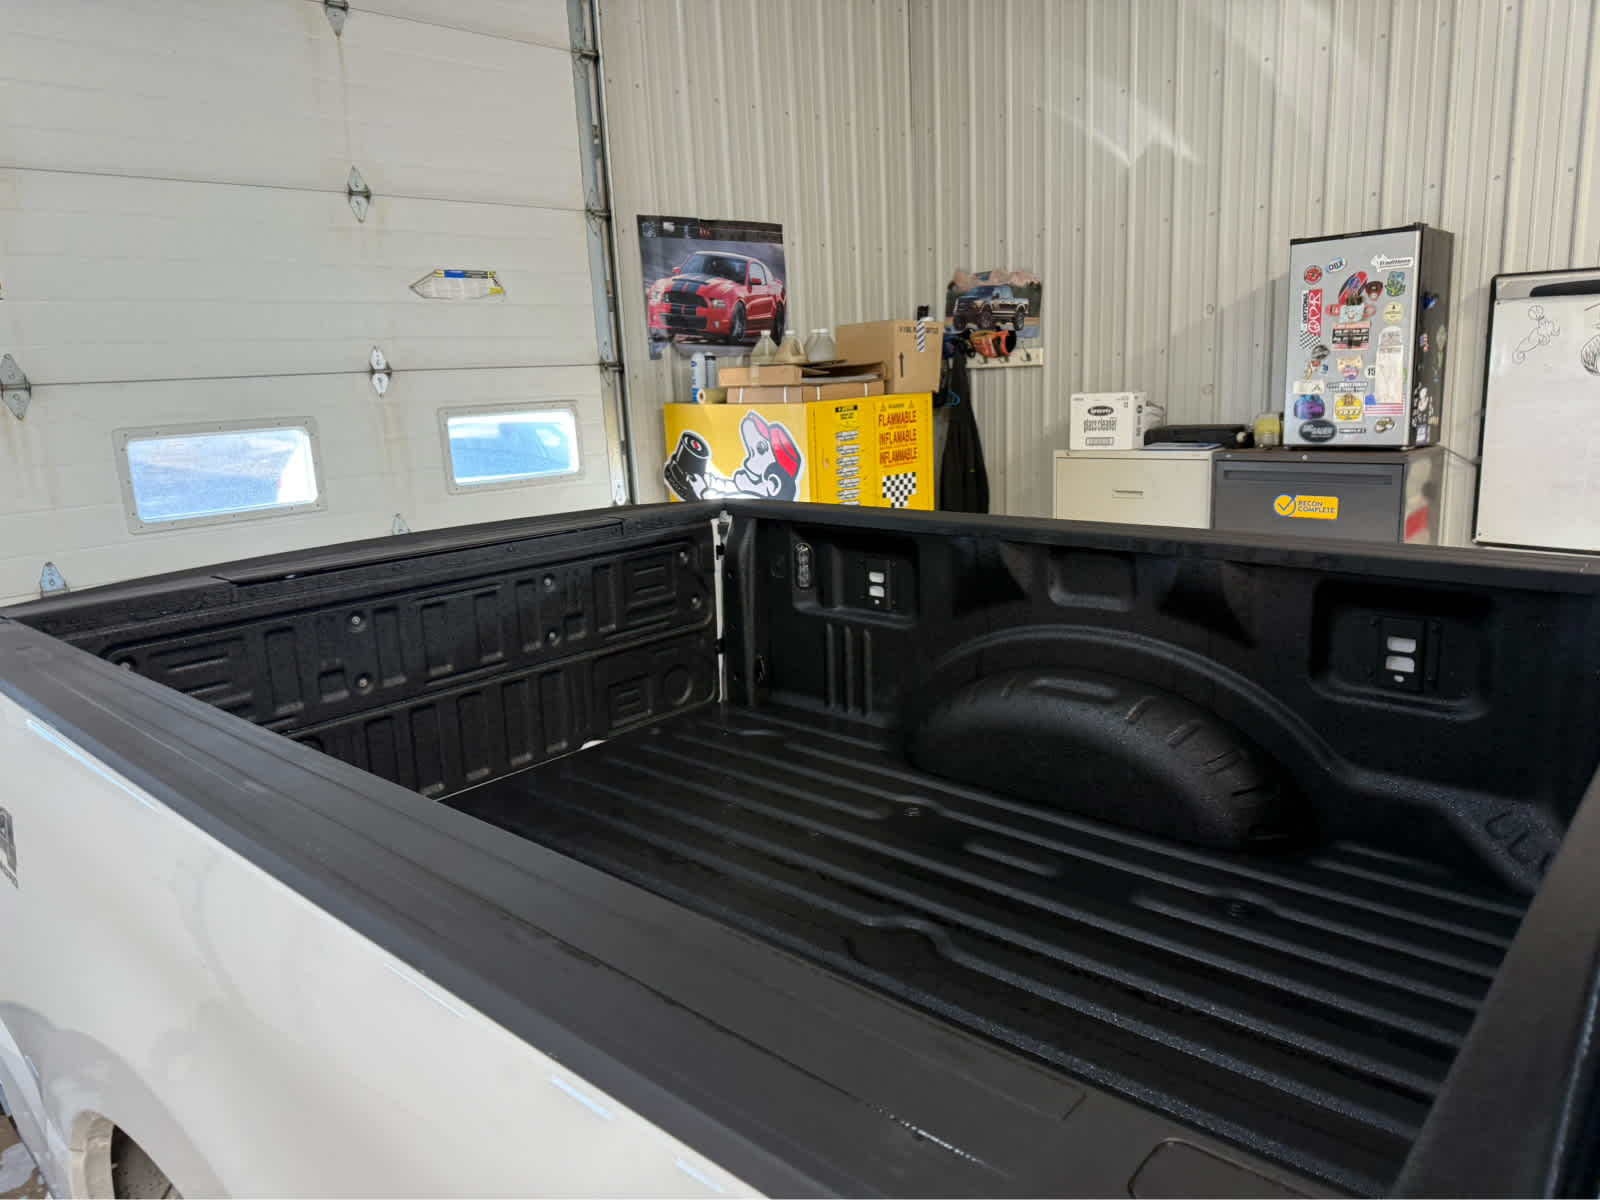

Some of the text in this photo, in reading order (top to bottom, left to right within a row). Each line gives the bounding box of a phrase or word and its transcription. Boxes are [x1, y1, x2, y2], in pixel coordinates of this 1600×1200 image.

[878, 410, 917, 426] FLAMMABLE
[1083, 417, 1117, 433] glass cleaner
[879, 428, 917, 445] INFLAMABLE
[880, 447, 918, 464] INFLAMMABLE
[1298, 506, 1336, 514] COMPLETE
